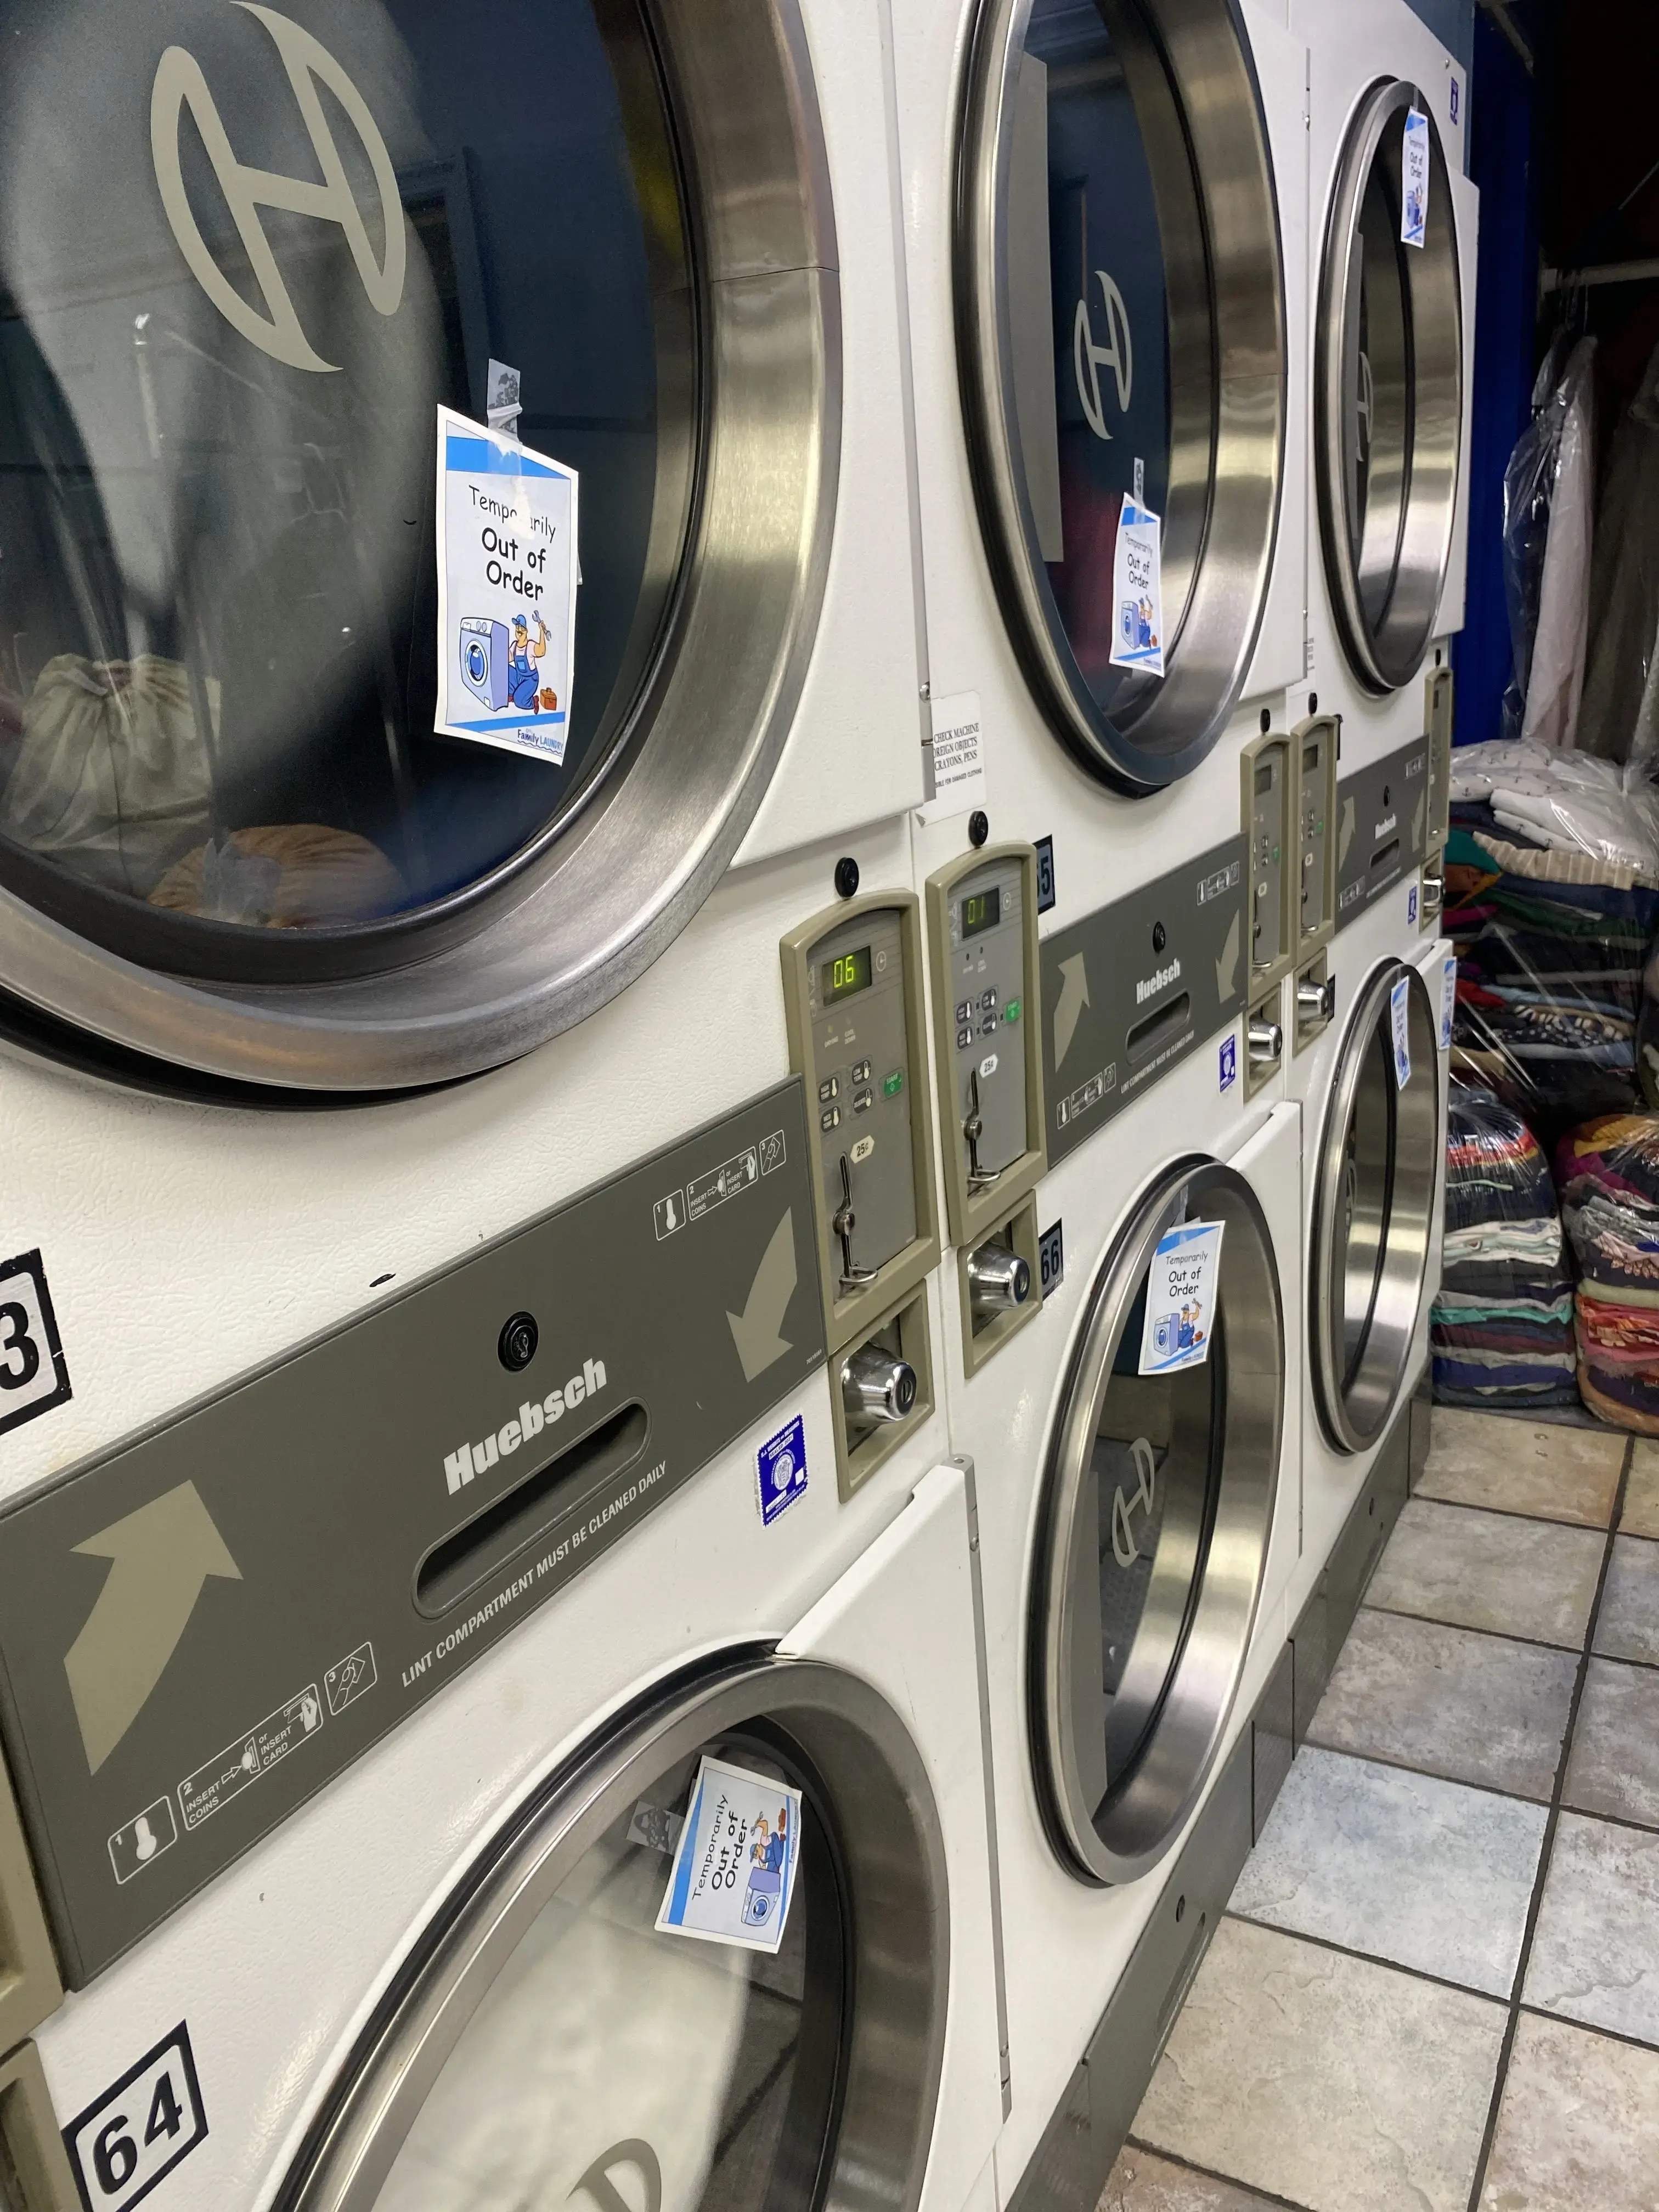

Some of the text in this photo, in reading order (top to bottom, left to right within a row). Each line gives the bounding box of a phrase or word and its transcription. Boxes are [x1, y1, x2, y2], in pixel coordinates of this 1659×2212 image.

[482, 527, 546, 573] Out of
[1127, 553, 1150, 575] Out of
[486, 560, 543, 601] Order
[1128, 571, 1148, 590] Order
[518, 729, 563, 752] Family LAUNDRY
[934, 723, 979, 744] CHECK MACHINE
[933, 736, 977, 758] OREIGN OBJECTS
[934, 749, 978, 771] CRAYONS, PENS
[1037, 856, 1050, 898] 5
[834, 955, 854, 988] 06
[1136, 957, 1180, 1005] Huebsch
[886, 1073, 898, 1085] START
[856, 1142, 869, 1156] 25¢
[726, 1171, 743, 1186] INSERT
[727, 1182, 741, 1194] CARD
[690, 1192, 708, 1207] INSERT
[691, 1203, 707, 1216] COINS
[1040, 1239, 1059, 1285] 66
[1165, 1250, 1208, 1266] Temporarily
[1169, 1266, 1201, 1283] Out of
[1169, 1283, 1199, 1297] Order
[443, 1358, 607, 1496] Huebsch
[770, 1443, 783, 1458] SEALED
[402, 1460, 668, 1688] LINT COMPARTMENT MUST BE CLEANED DAILY
[329, 1671, 336, 1682] 3
[258, 1733, 268, 1744] or
[261, 1725, 292, 1754] INSERT
[263, 1742, 289, 1766] CARD
[183, 1782, 193, 1796] 2
[187, 1781, 220, 1813] INSERT
[189, 1796, 219, 1824] COINS
[692, 1794, 729, 1901] Temporarily
[712, 1810, 738, 1891] Out of
[725, 1819, 748, 1889] Order
[93, 2070, 183, 2195] 64
